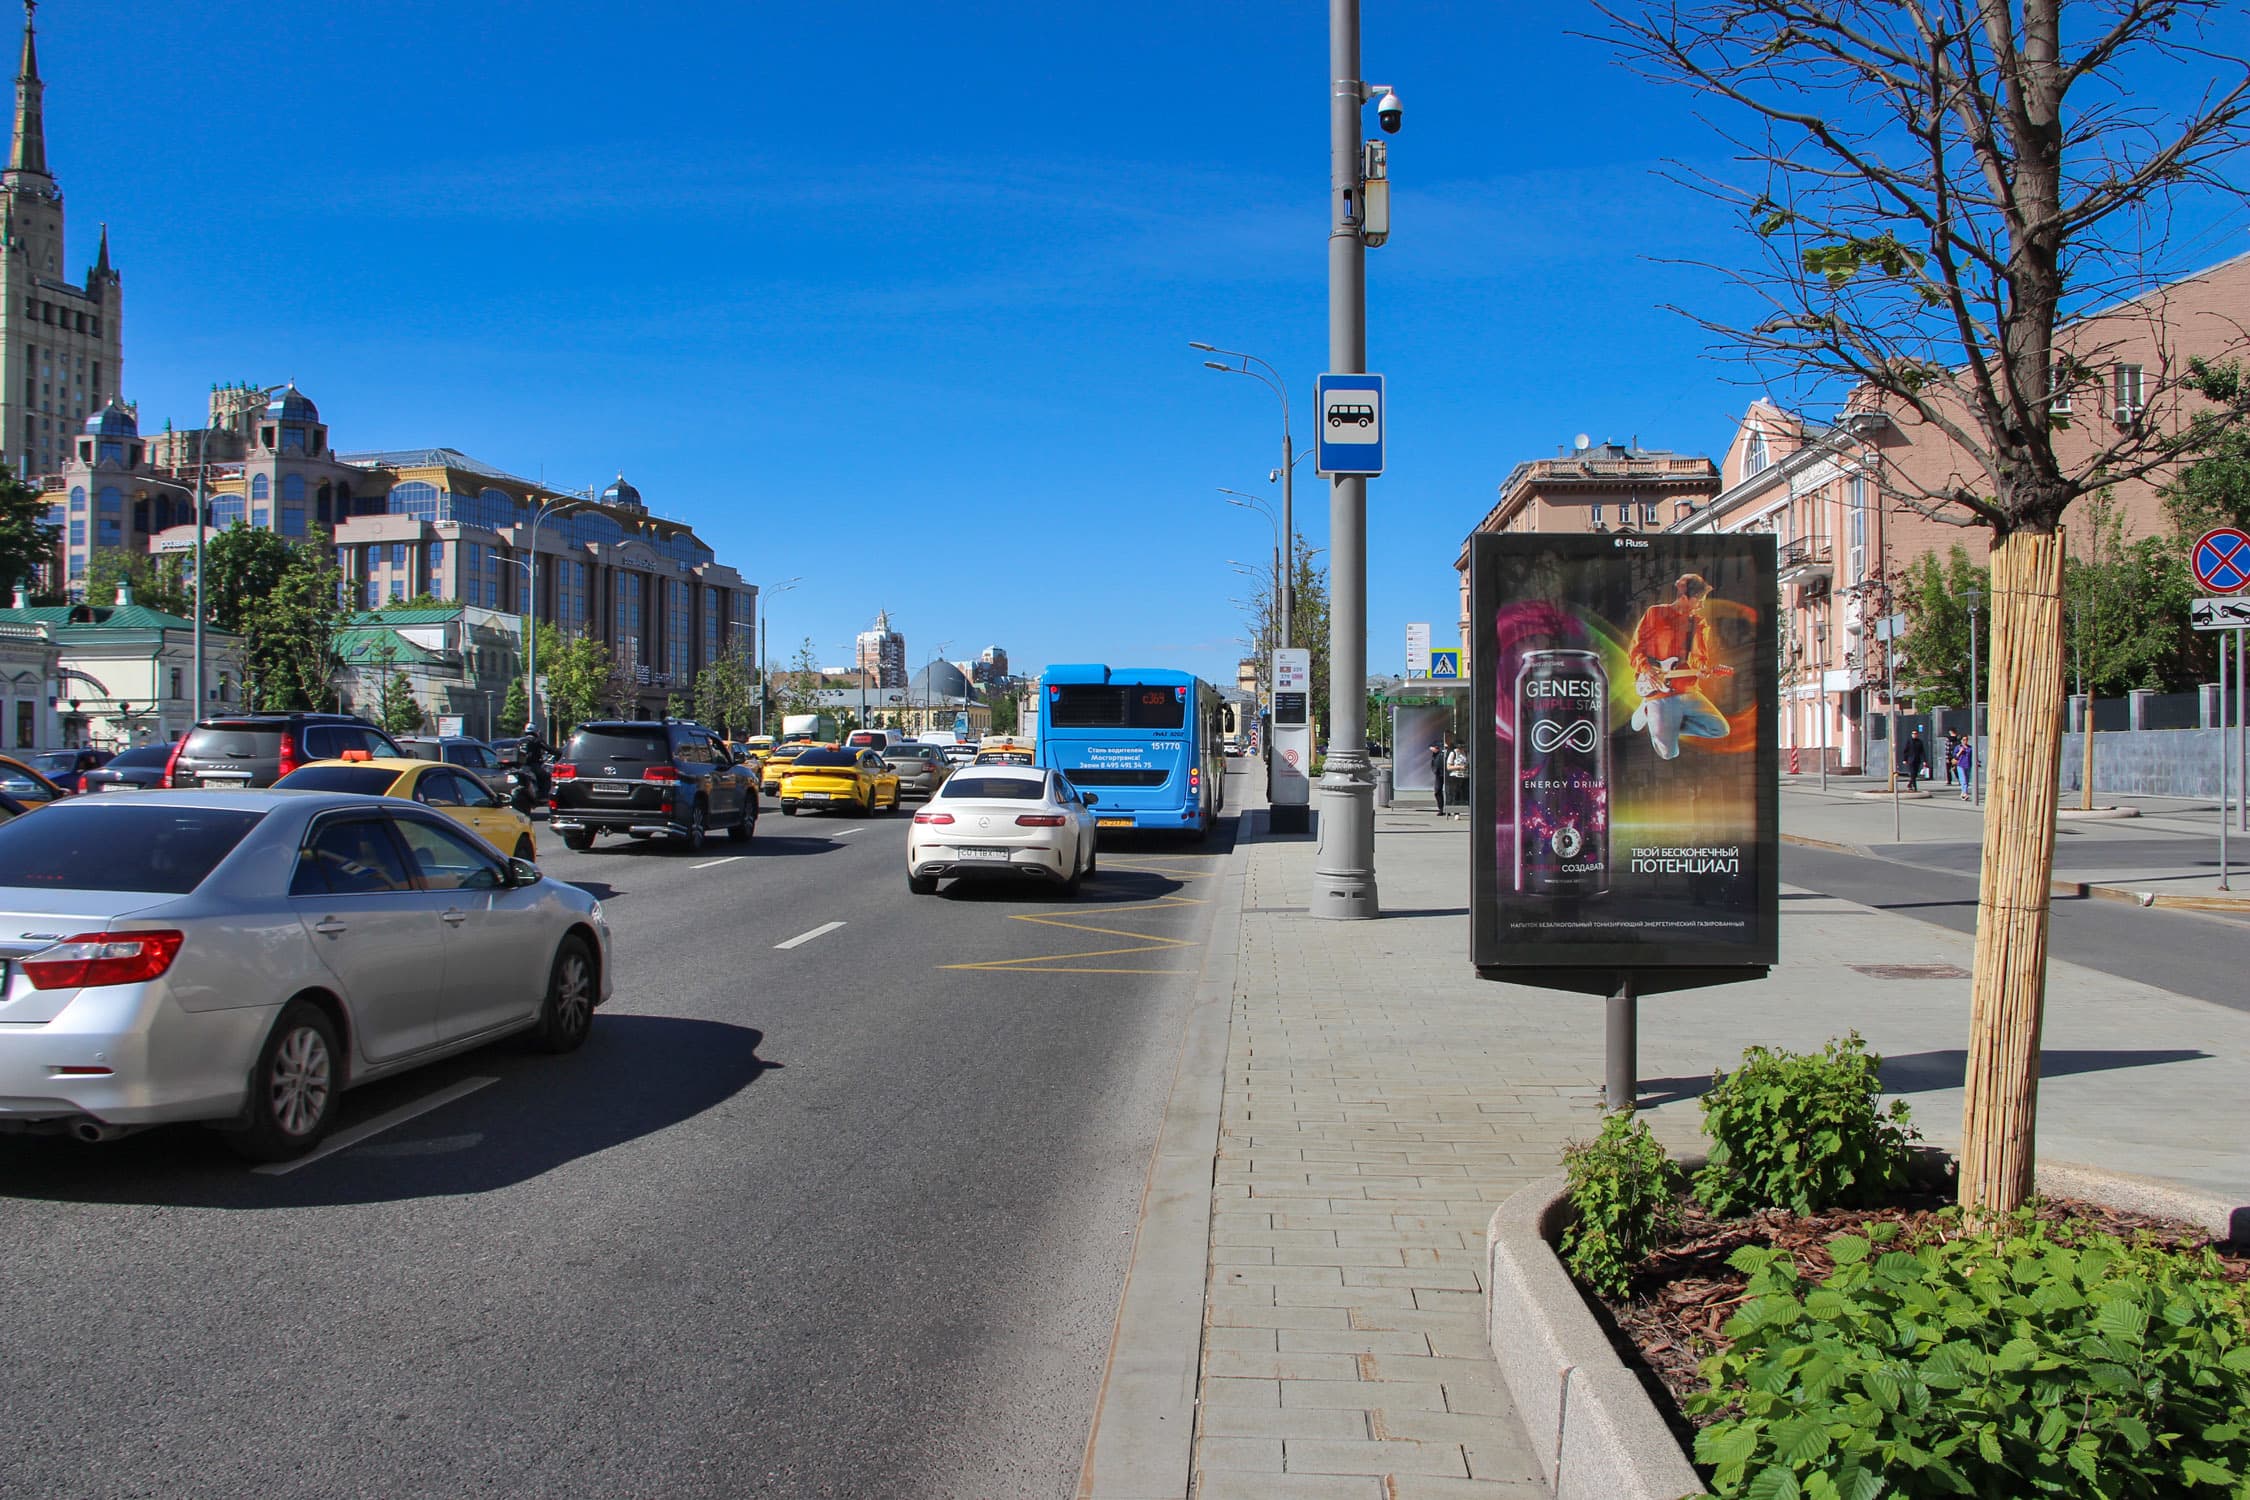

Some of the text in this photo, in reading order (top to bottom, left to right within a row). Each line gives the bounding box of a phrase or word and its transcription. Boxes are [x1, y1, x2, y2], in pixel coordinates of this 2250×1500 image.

[1625, 538, 1648, 548] Russ
[1526, 680, 1602, 697] GENESIS
[1151, 742, 1180, 750] 151770
[1524, 780, 1568, 789] ENERGY
[1631, 846, 1739, 857] ТВОЙ БЕСКОНЕЧНЫЙ
[1631, 858, 1739, 874] ПОТЕНЦИАЛ
